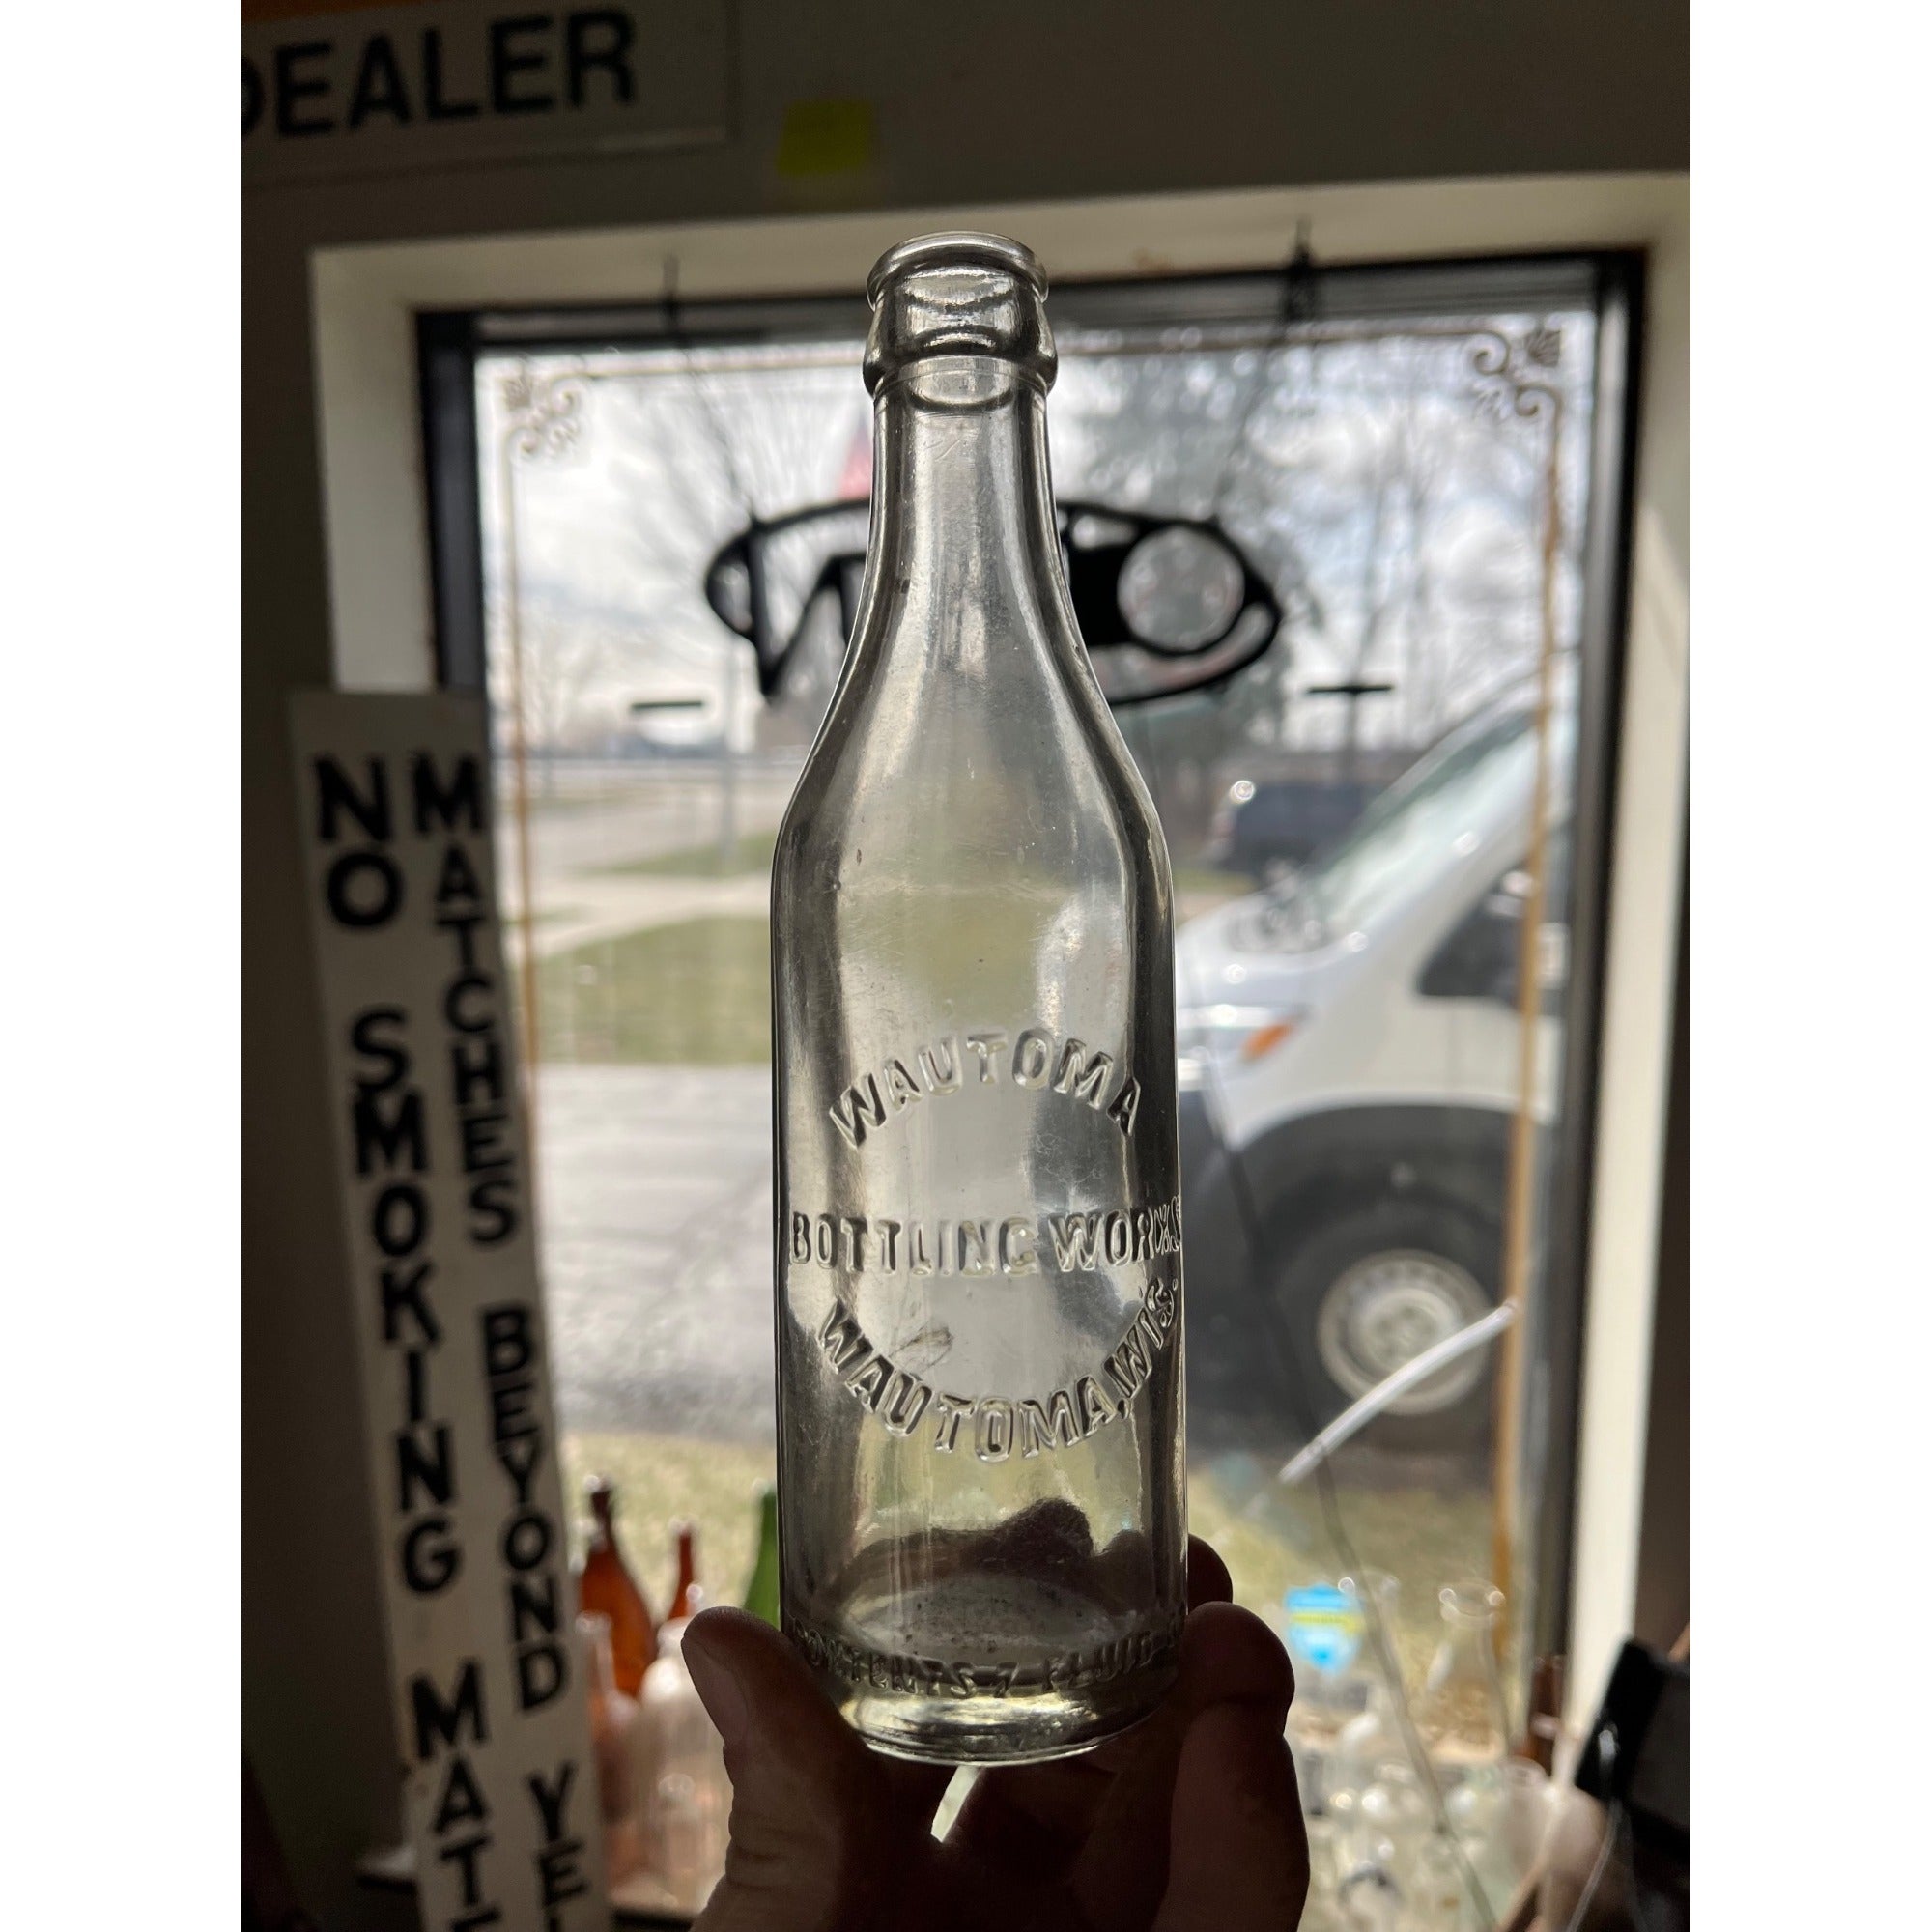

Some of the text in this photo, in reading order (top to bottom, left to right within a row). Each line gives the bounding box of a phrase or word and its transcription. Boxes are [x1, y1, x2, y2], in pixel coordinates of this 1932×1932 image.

[829, 1027, 1142, 1150] WAUTOMA
[787, 1194, 1182, 1276] BOTTLING WORKS
[314, 753, 501, 1932] NO SMOKING MAT
[412, 752, 587, 1932] MATCHES BEYOND YE
[993, 1661, 1020, 1698] 7
